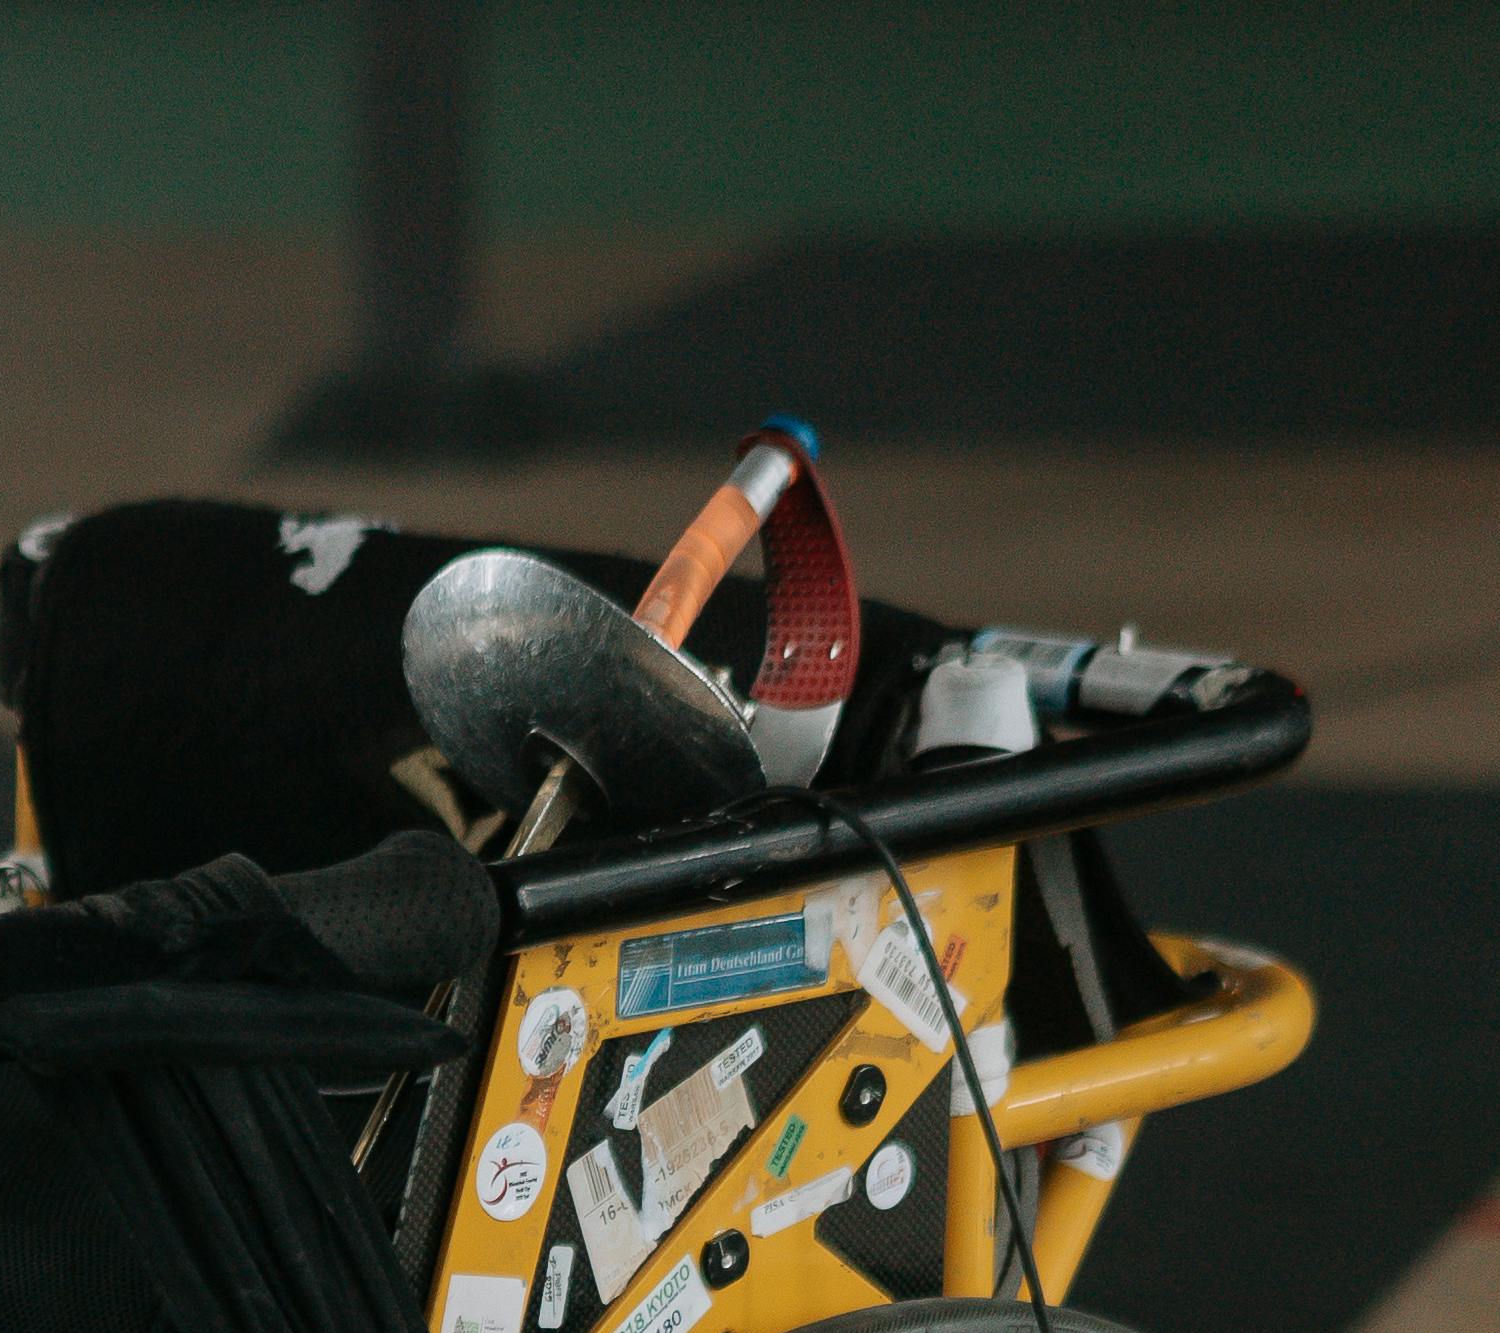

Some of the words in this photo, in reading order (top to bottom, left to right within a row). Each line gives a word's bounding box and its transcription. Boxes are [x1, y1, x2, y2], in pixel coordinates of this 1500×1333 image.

[709, 946, 783, 972] Deutschland
[718, 1038, 752, 1071] TESTED
[617, 1063, 636, 1119] TESED
[644, 1264, 695, 1317] KYOTO
